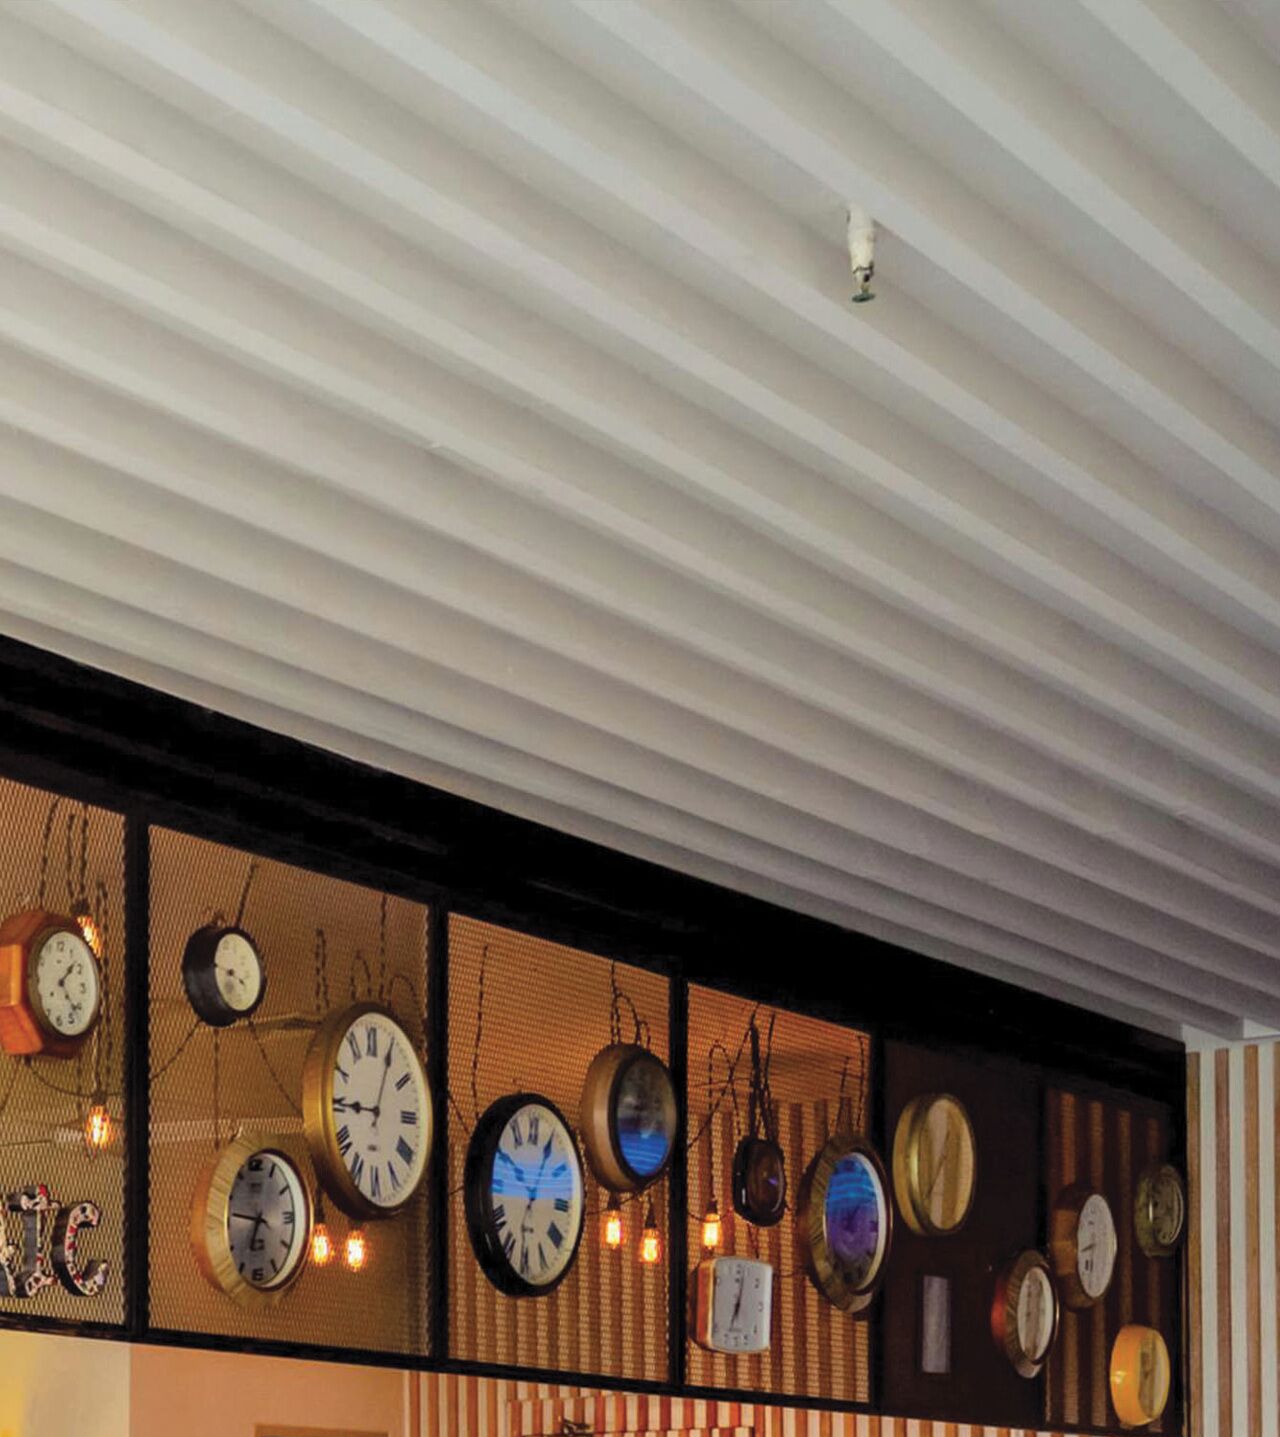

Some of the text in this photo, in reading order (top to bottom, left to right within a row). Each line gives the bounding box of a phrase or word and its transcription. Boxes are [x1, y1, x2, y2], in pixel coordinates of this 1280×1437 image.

[56, 941, 65, 953] 12
[77, 963, 83, 975] 2
[80, 982, 86, 994] 3
[68, 1012, 75, 1024] 5
